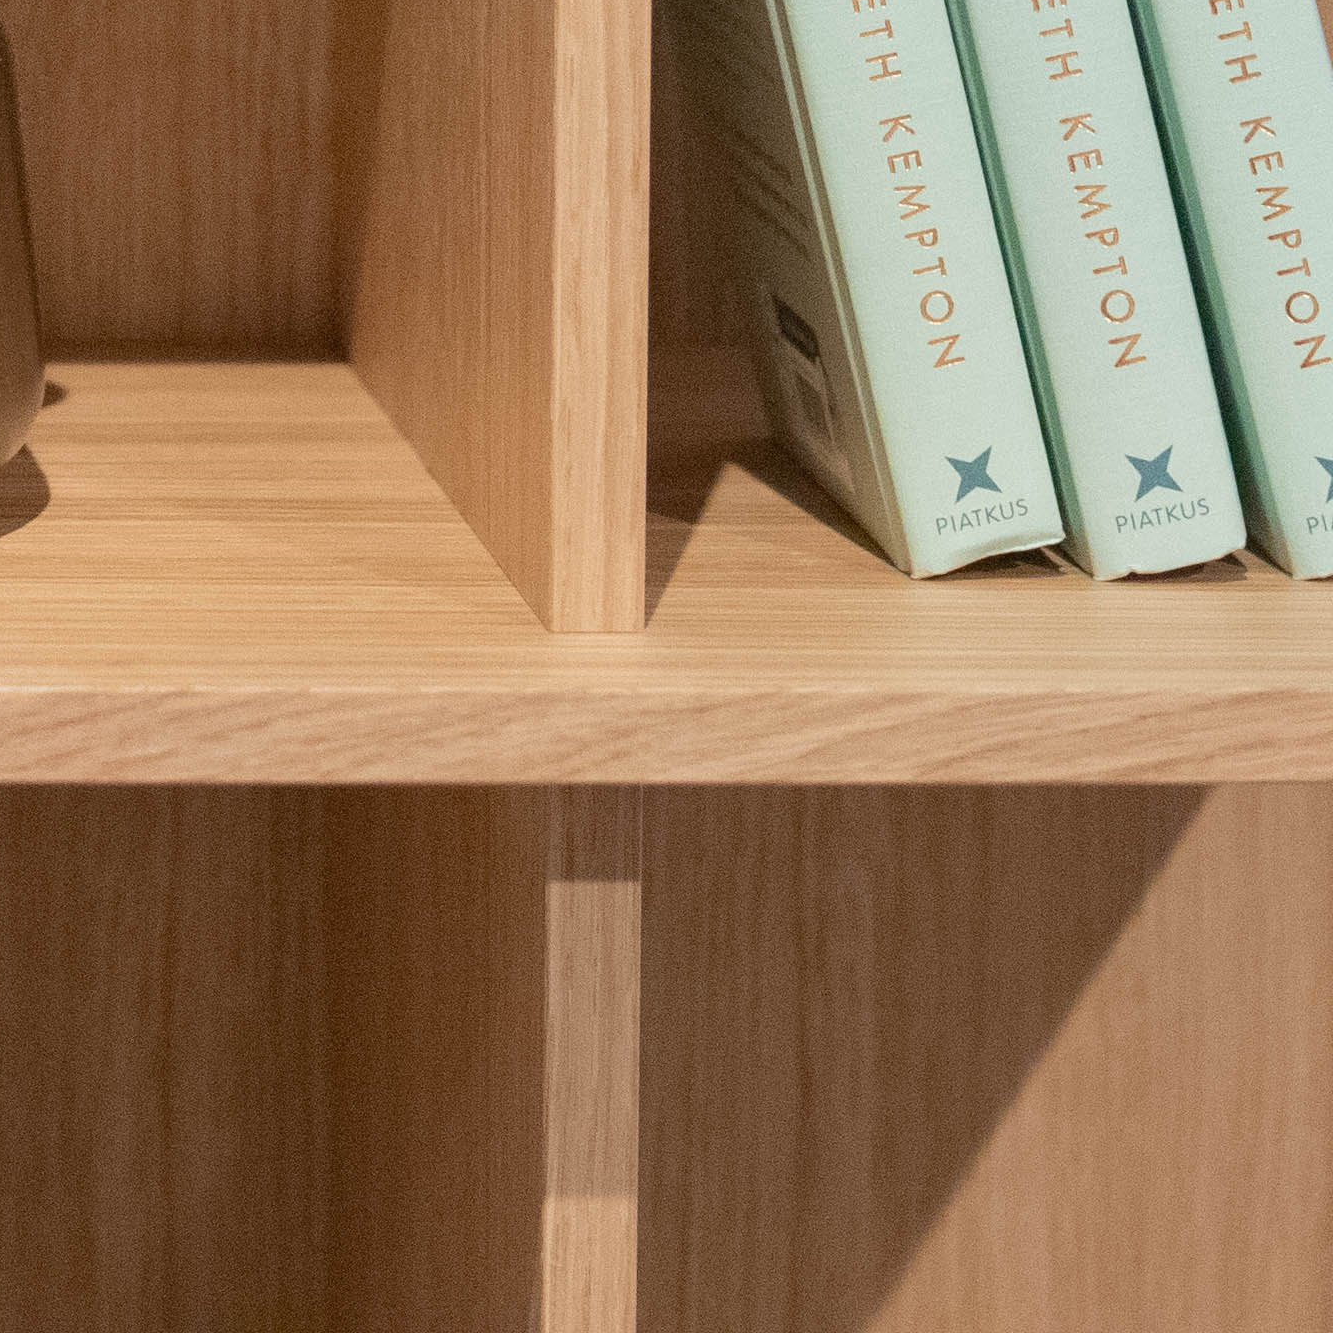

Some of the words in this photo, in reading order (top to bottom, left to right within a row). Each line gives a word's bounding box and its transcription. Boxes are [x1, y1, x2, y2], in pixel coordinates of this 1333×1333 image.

[878, 113, 966, 369] KEMPTON
[1058, 112, 1147, 369] KEMPTON
[1239, 115, 1332, 370] KEMPTON
[935, 497, 1029, 536] PIATKUS
[1114, 497, 1211, 534] PIATKUS
